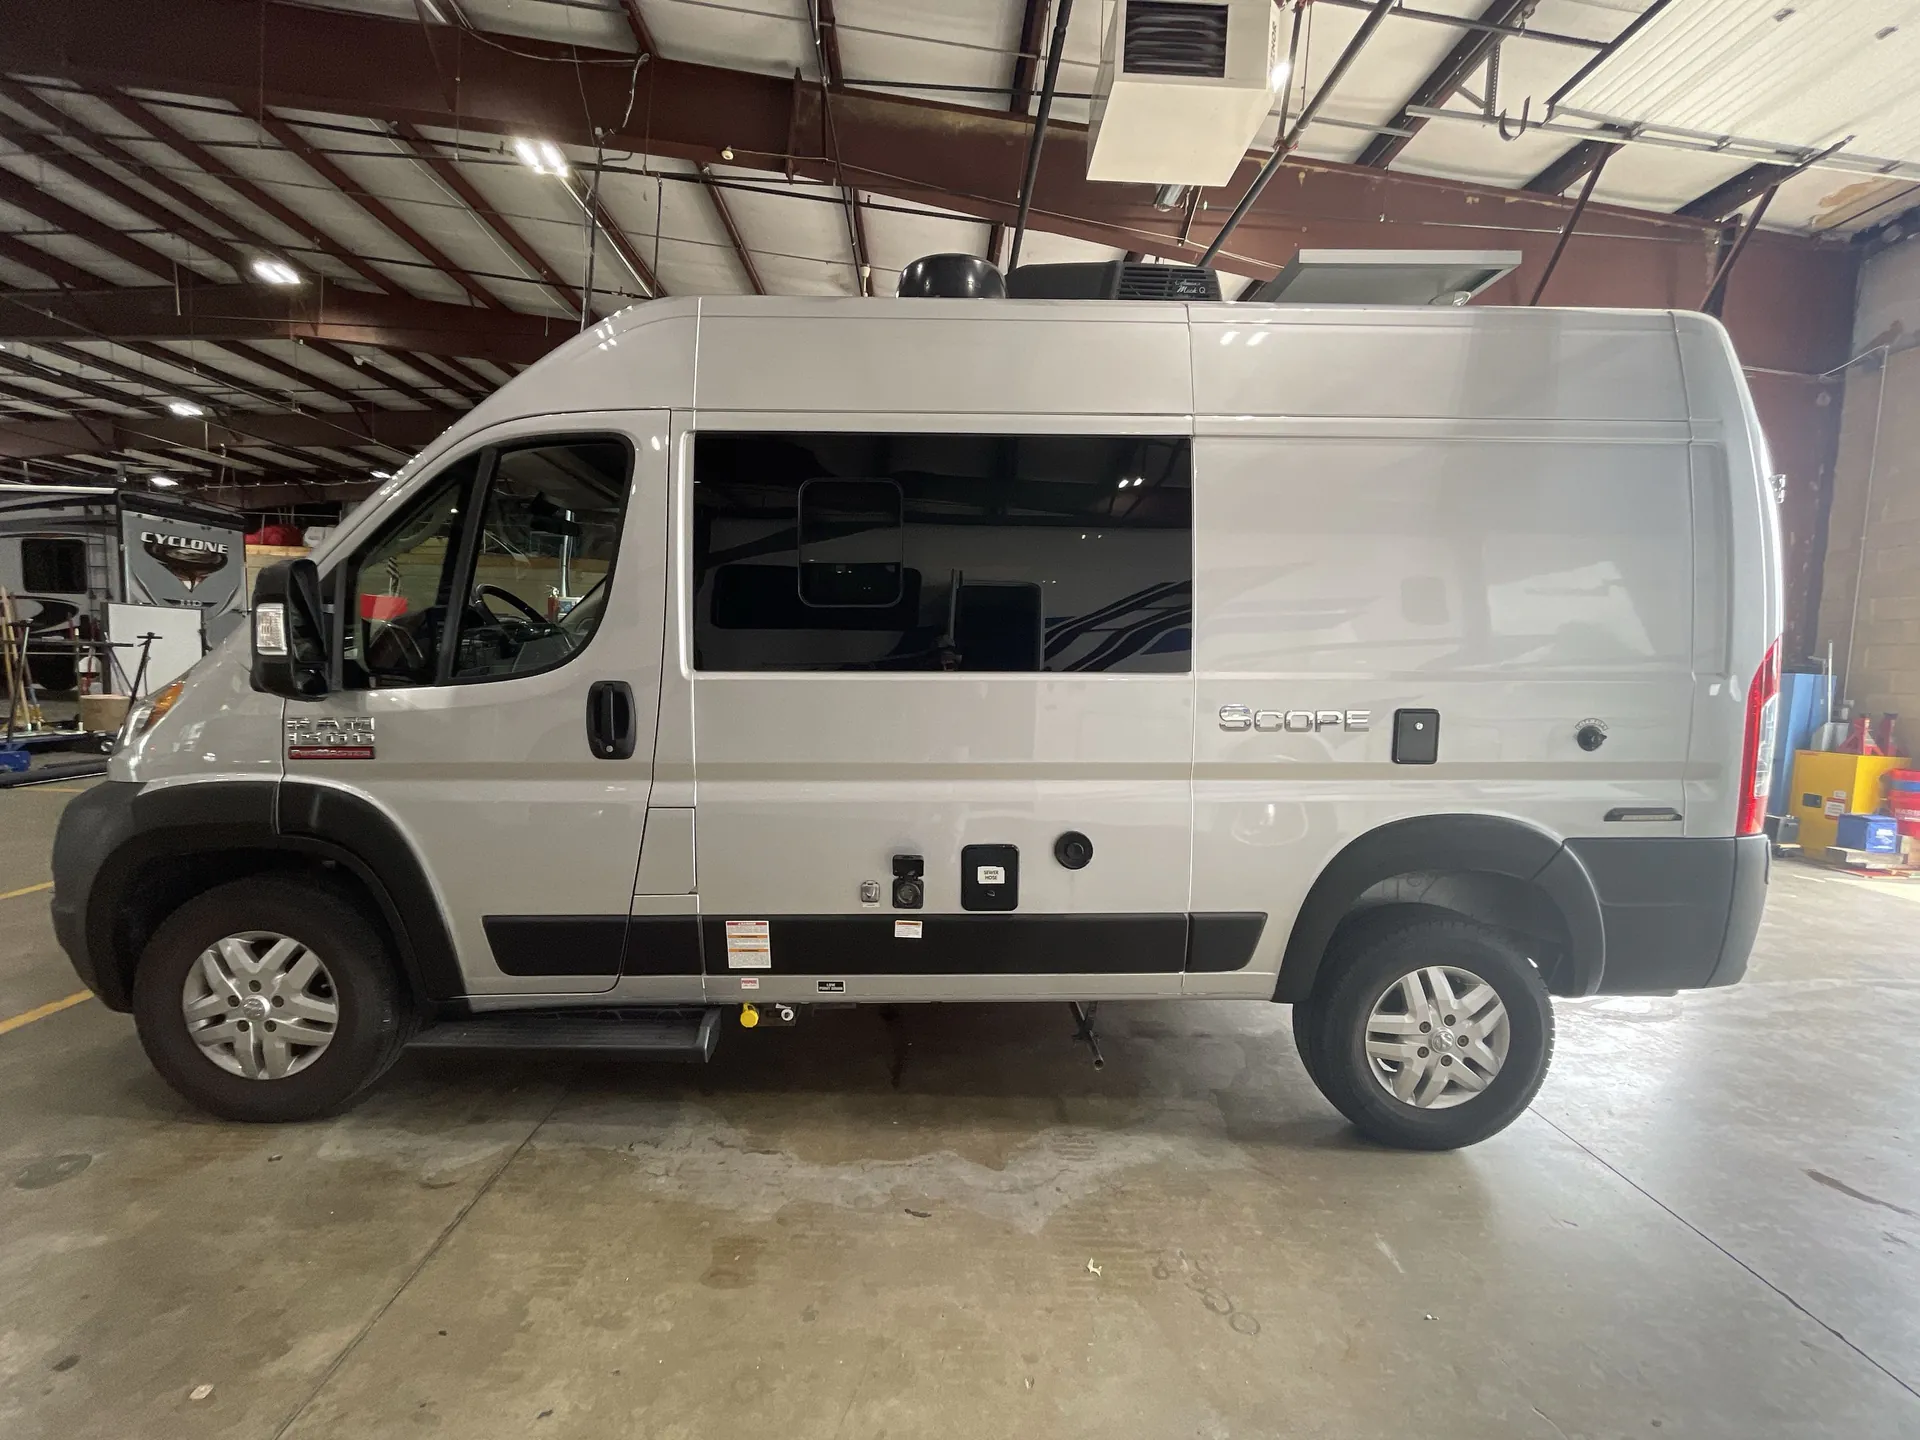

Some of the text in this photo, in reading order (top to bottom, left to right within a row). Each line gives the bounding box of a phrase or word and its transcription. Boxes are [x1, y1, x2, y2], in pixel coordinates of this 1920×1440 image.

[1198, 286, 1206, 294] Q
[140, 531, 229, 554] CYCLONE
[286, 716, 375, 731] RAM
